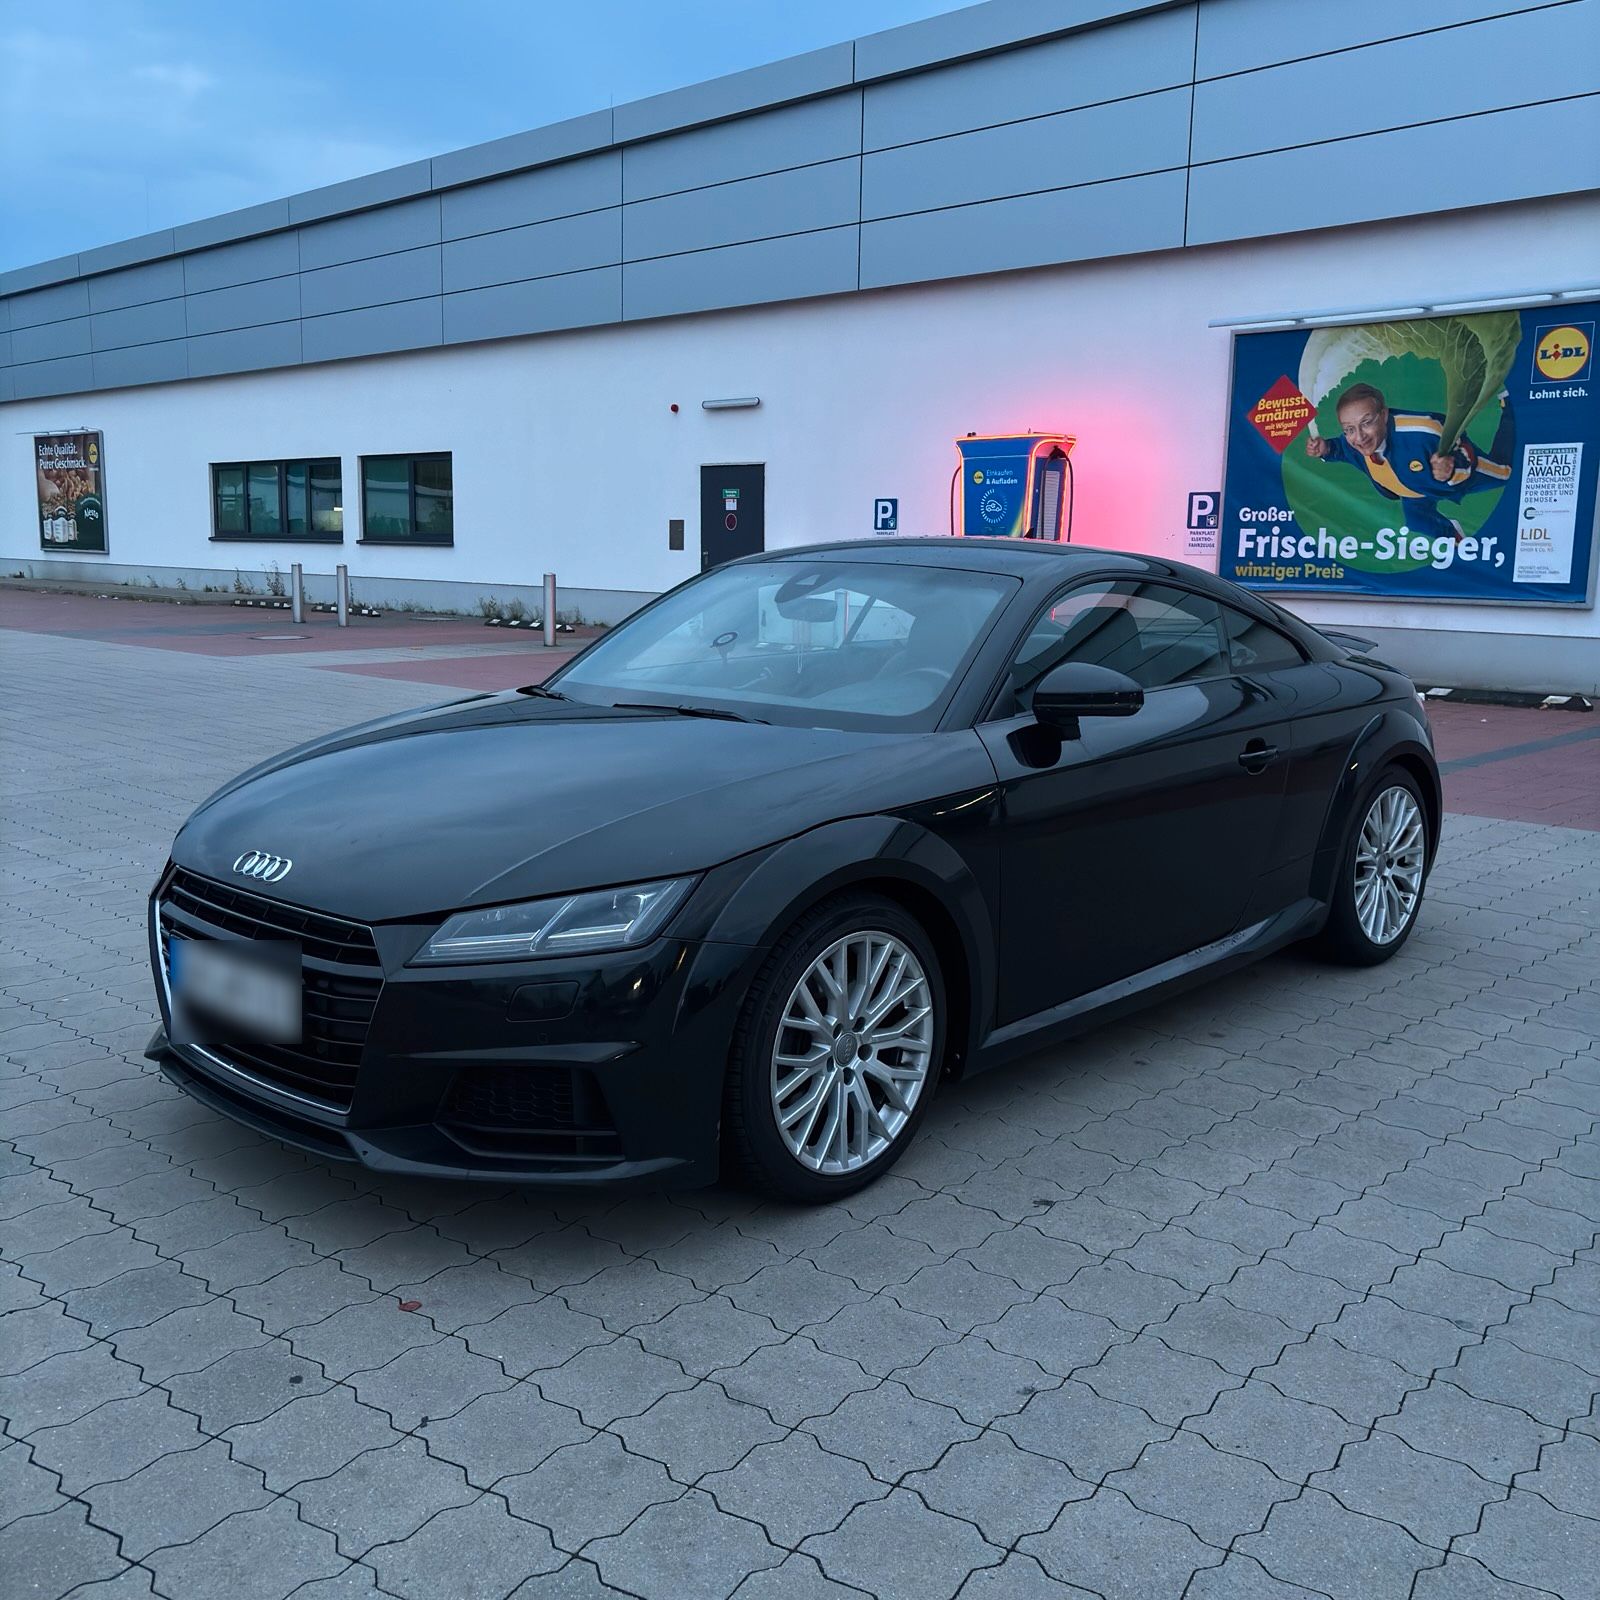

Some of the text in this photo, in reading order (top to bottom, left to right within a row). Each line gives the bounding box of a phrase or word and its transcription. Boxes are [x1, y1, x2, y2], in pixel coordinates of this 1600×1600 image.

[1540, 343, 1585, 361] LIDL
[1529, 387, 1588, 399] Lohnt sich.
[1257, 396, 1306, 410] Bewusst
[1255, 407, 1308, 423] ernähren
[38, 446, 53, 456] Echte
[54, 442, 78, 457] Qualität.
[40, 458, 87, 469] Purer Geschmack.
[1528, 454, 1571, 466] RETAIL
[1528, 466, 1571, 477] AWARD
[877, 501, 892, 528] P
[1191, 495, 1213, 527] P
[1239, 507, 1294, 521] Großer
[1521, 528, 1551, 540] LIDL
[1238, 526, 1505, 570] Frische-Sieger,
[1235, 562, 1344, 581] winziger Preis
